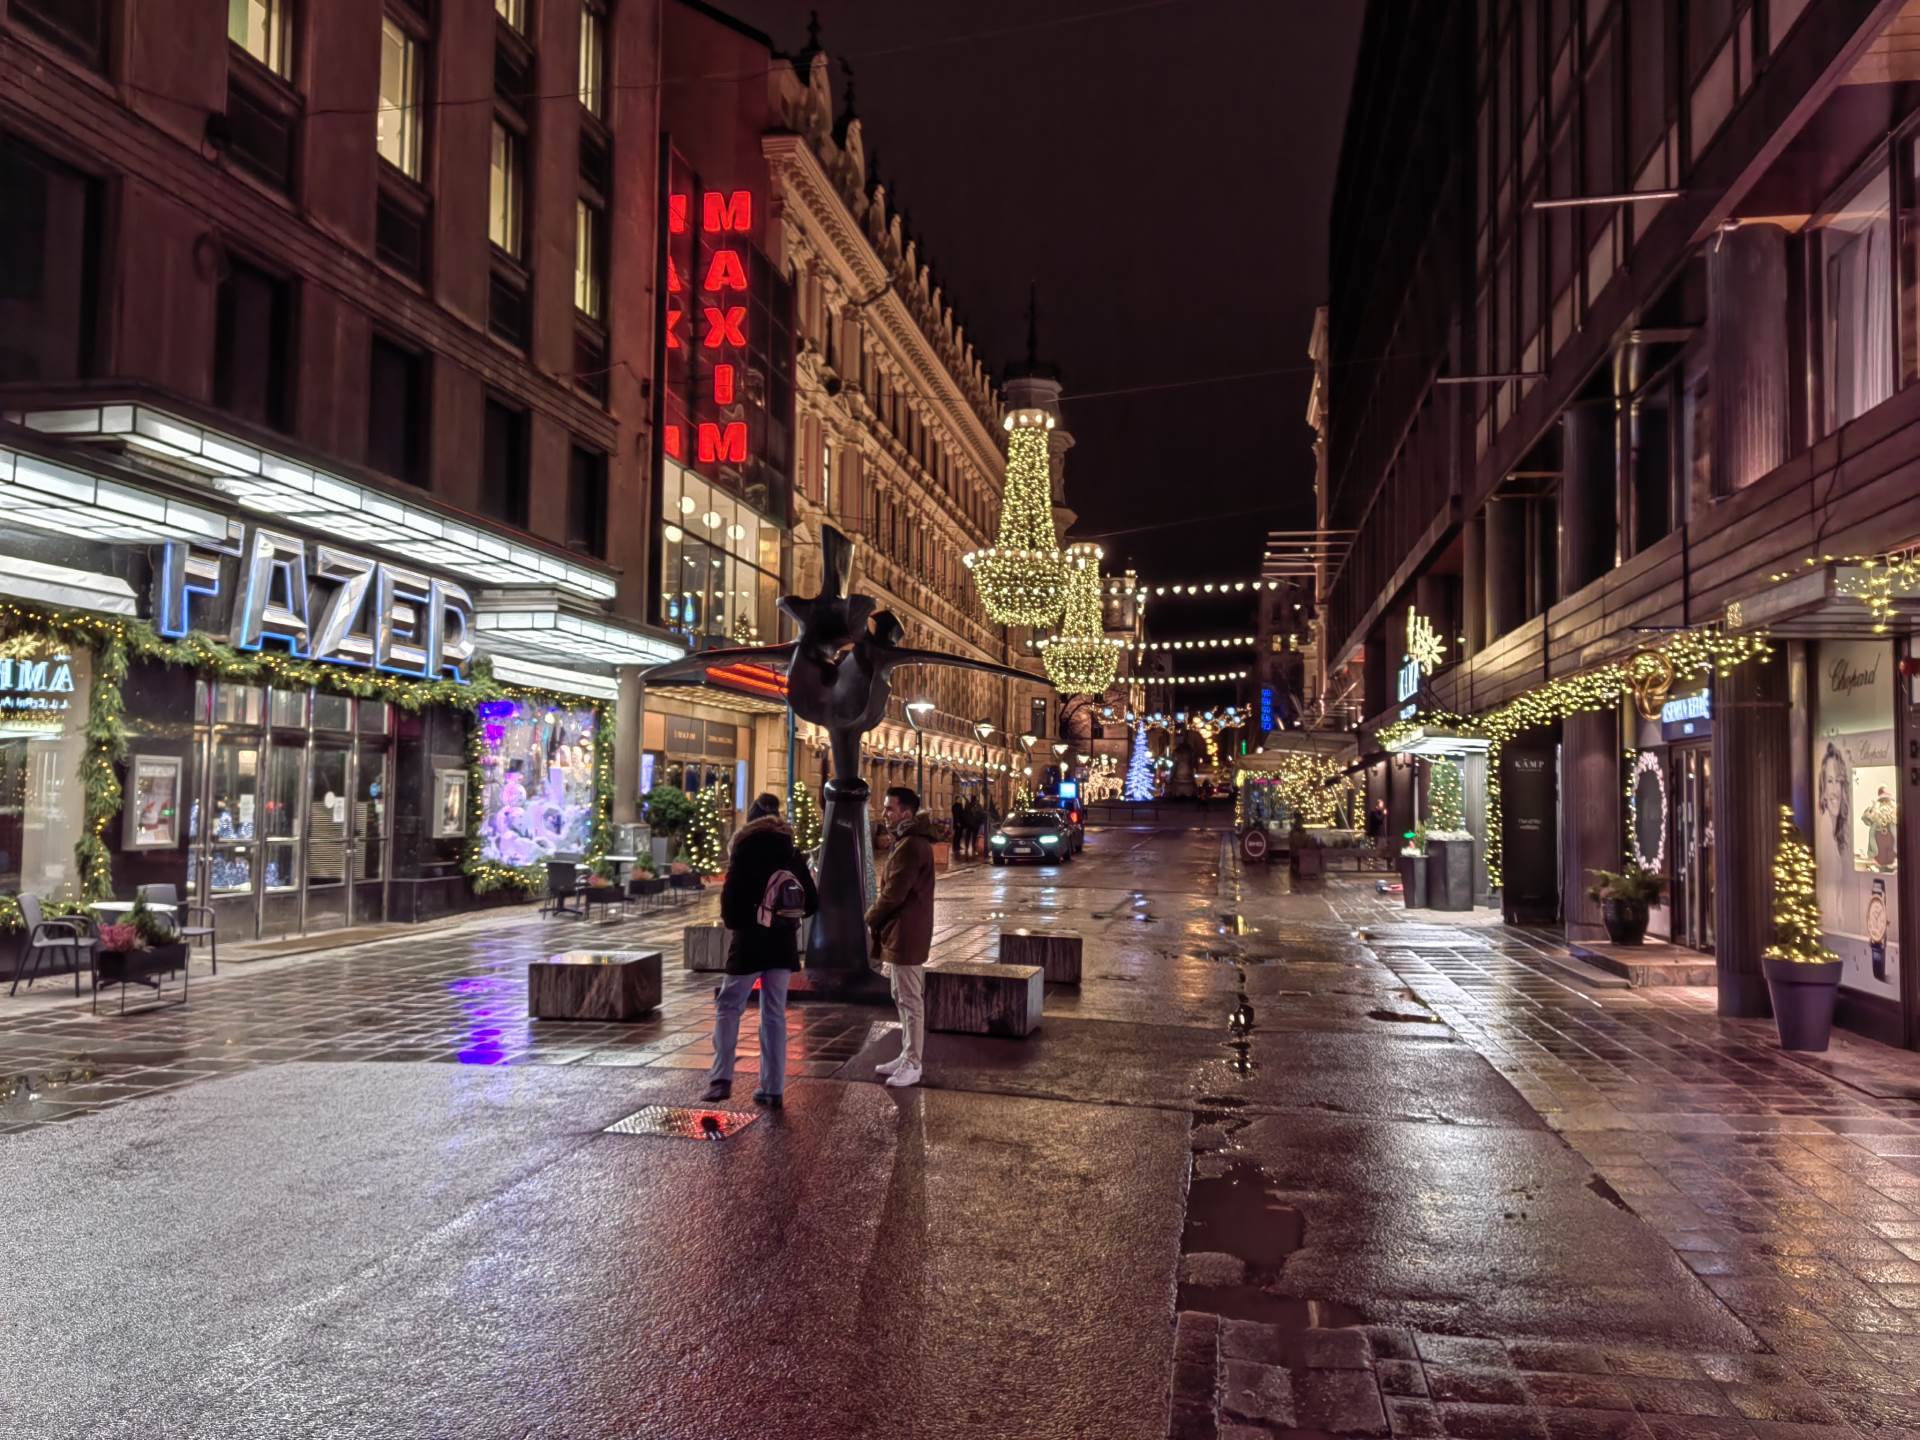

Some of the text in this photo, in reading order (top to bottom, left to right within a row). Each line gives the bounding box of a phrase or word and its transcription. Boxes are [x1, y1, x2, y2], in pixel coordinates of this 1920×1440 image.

[697, 190, 752, 463] MAXIM
[160, 518, 475, 685] FAZER
[1829, 653, 1881, 696] Chopard
